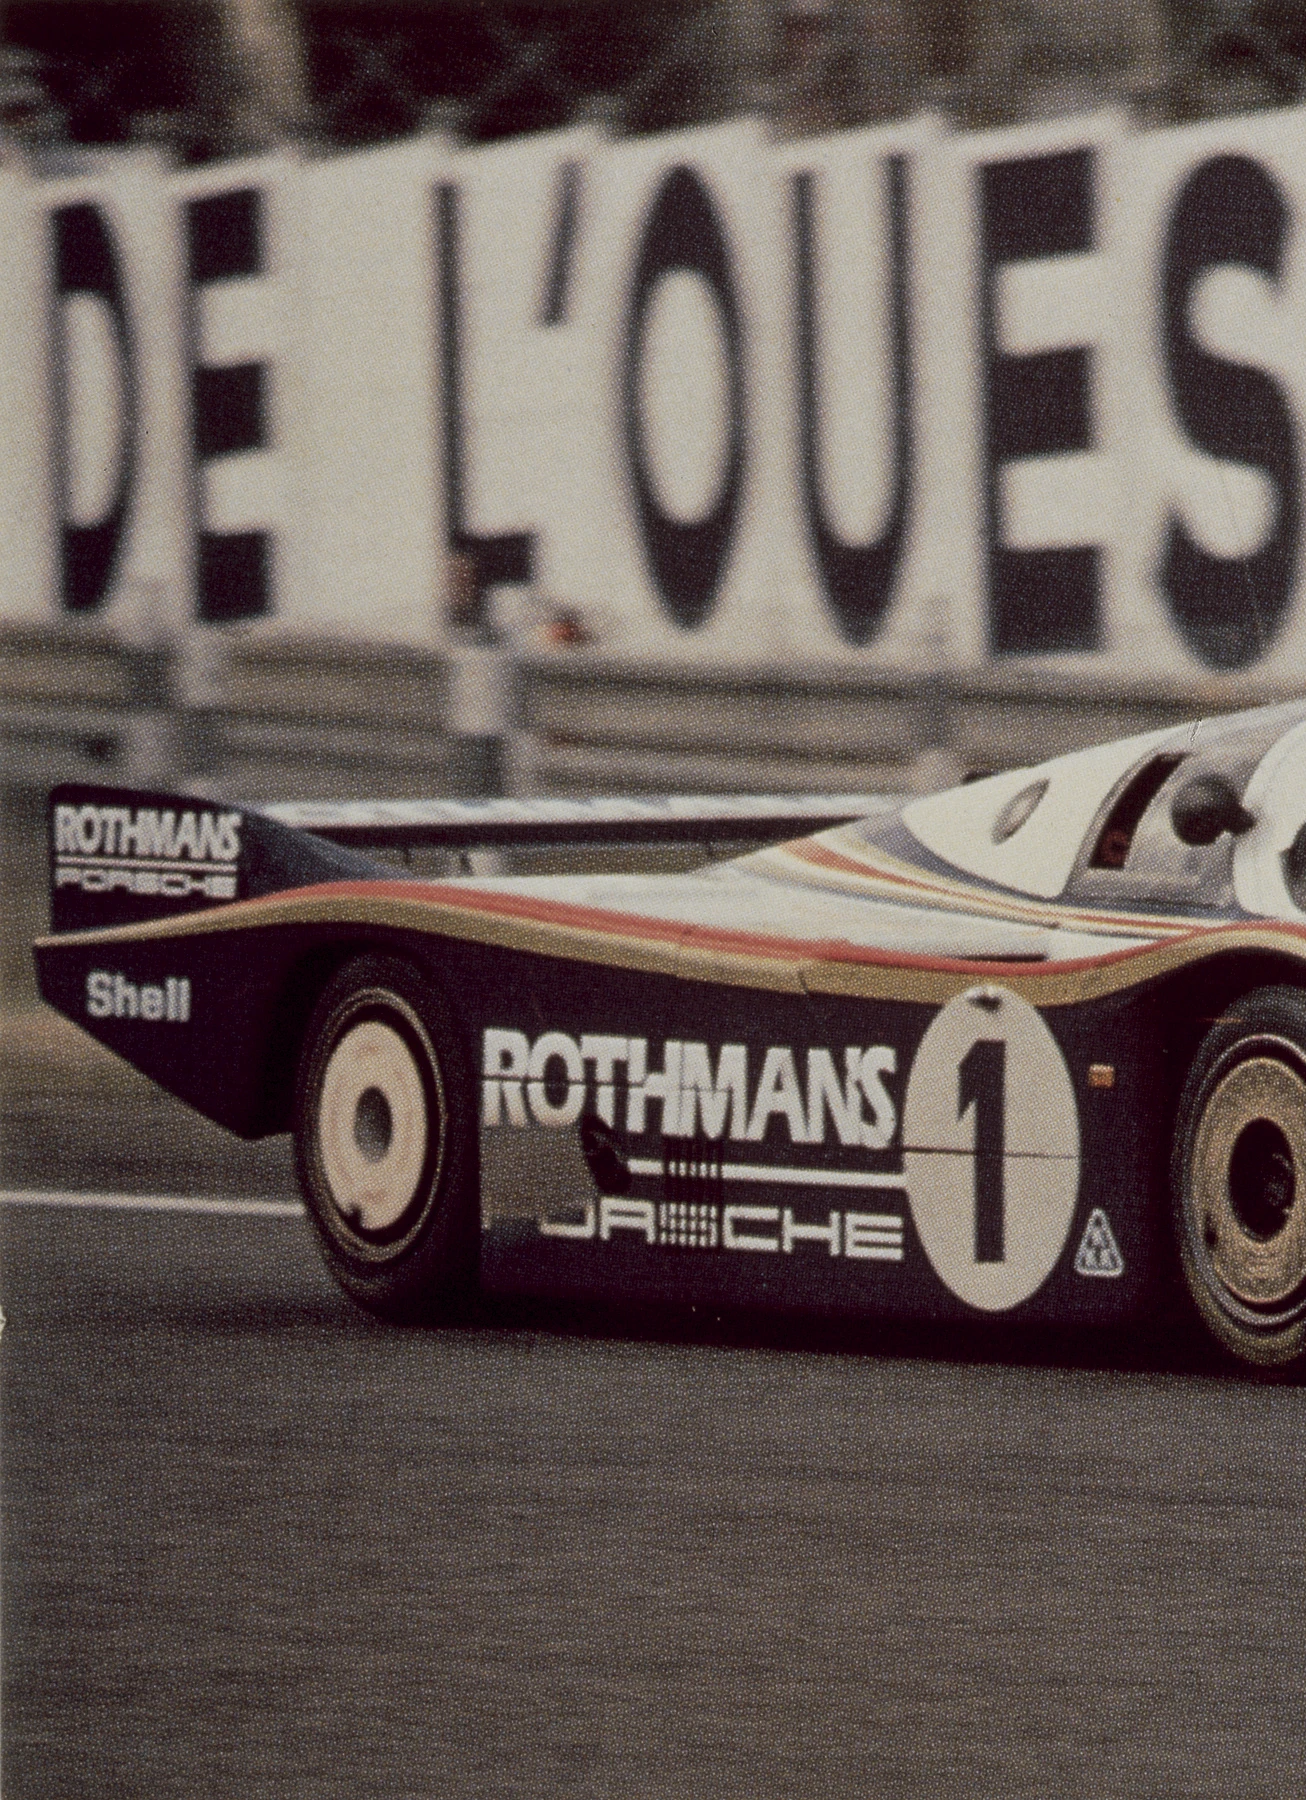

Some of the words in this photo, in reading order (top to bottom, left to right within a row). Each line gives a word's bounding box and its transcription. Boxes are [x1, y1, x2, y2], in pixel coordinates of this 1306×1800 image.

[50, 187, 272, 622] DE
[54, 804, 242, 861] ROTHMANS
[85, 969, 191, 1022] Shell
[482, 1028, 898, 1149] ROTHMANS
[957, 1038, 1006, 1265] 1
